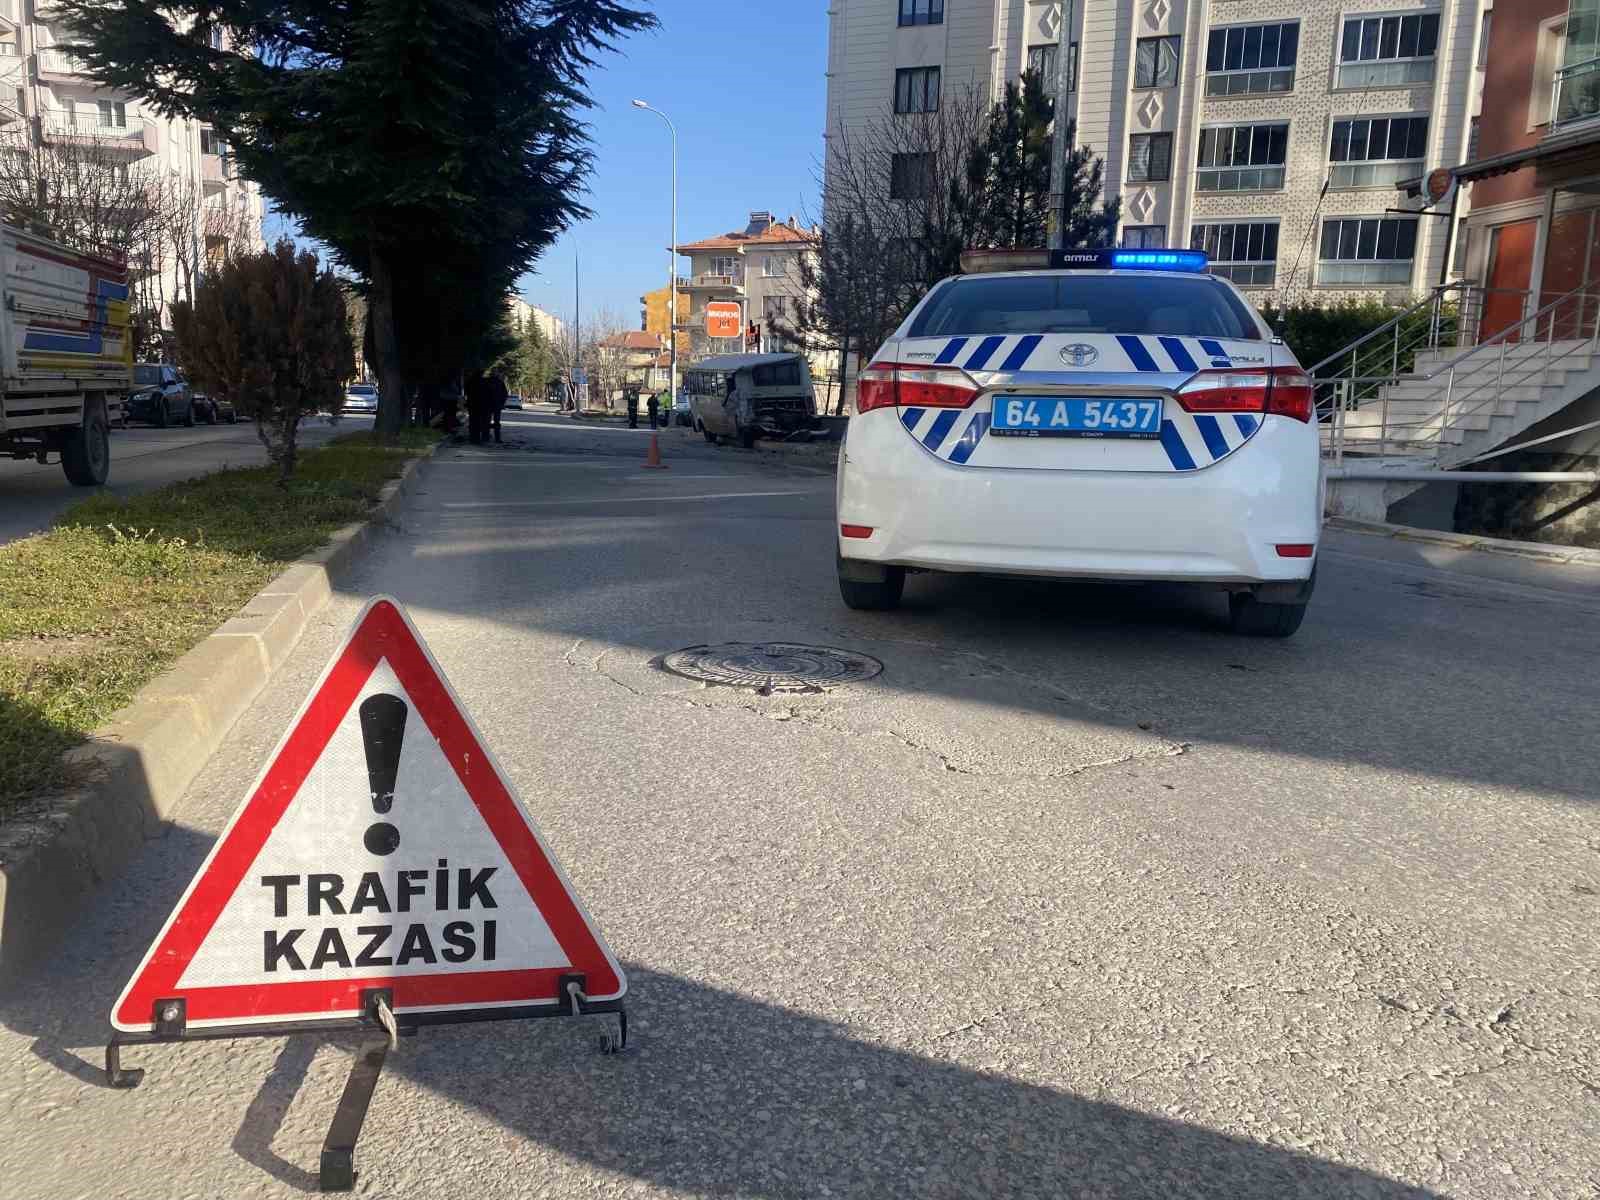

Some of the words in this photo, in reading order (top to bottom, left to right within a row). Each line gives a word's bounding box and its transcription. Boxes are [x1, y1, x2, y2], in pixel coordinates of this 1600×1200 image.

[708, 310, 738, 319] MIGROS
[1006, 400, 1040, 427] 64
[1050, 401, 1069, 428] A
[1083, 402, 1156, 430] 5437
[262, 859, 499, 917] TRAFİK
[263, 920, 497, 972] KAZASI
